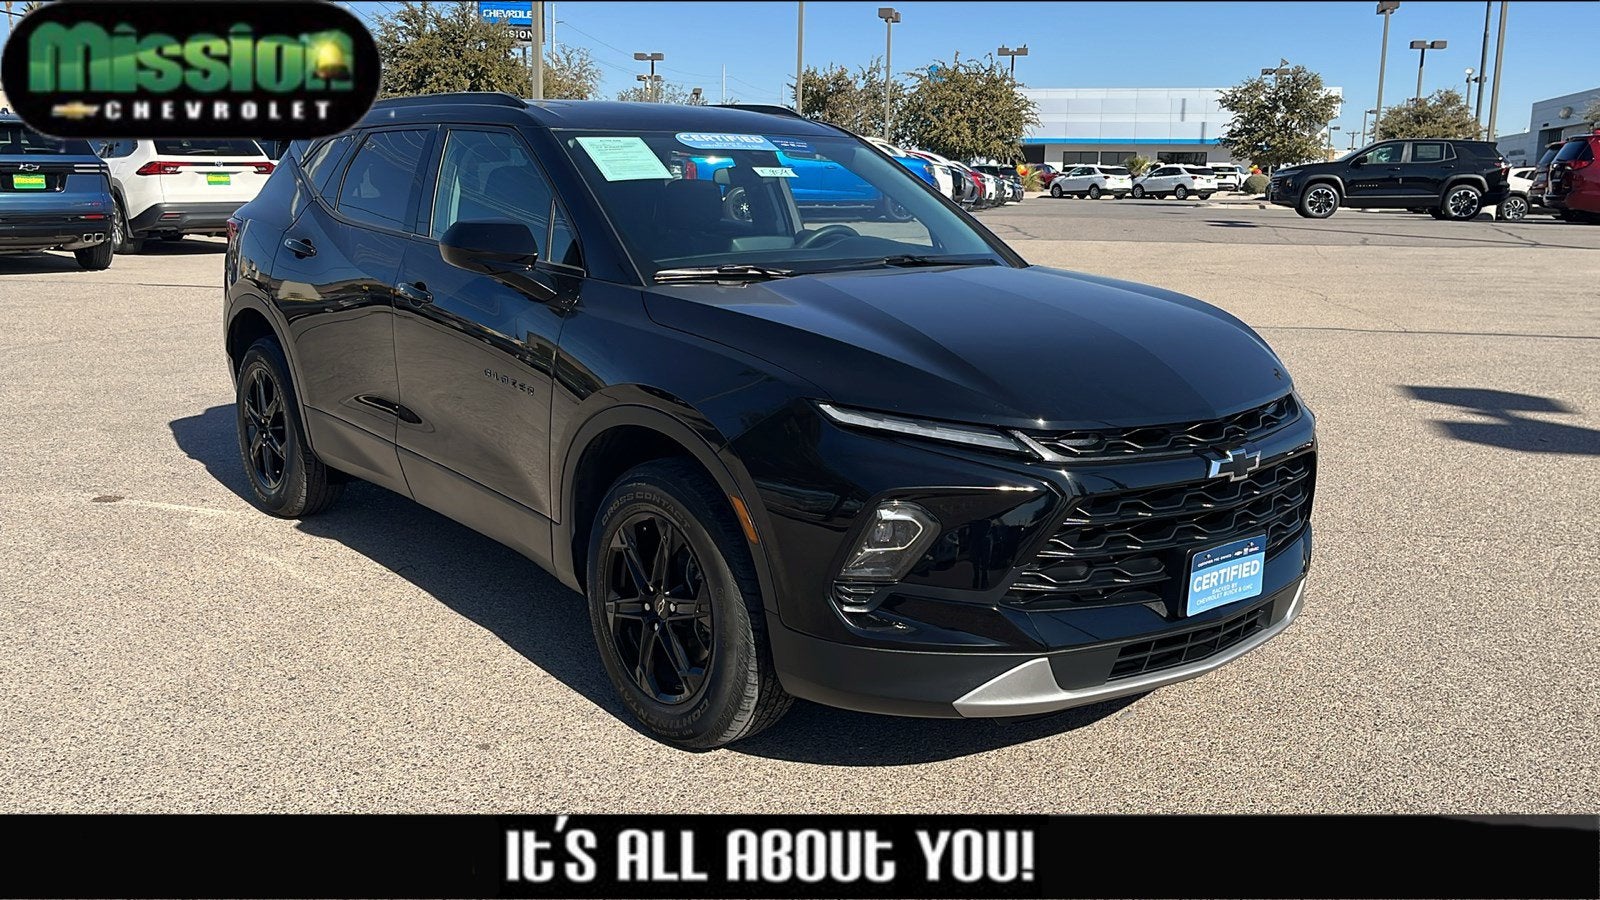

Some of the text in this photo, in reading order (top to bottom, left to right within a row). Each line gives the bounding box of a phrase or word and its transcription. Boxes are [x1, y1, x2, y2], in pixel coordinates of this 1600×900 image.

[483, 9, 532, 18] CHEVROLE
[679, 133, 765, 144] CERTIFIED
[484, 368, 535, 396] BLAZER
[1193, 559, 1261, 593] CERTIFIED
[1211, 585, 1231, 595] BACKED
[1196, 592, 1223, 606] CHEVROLET
